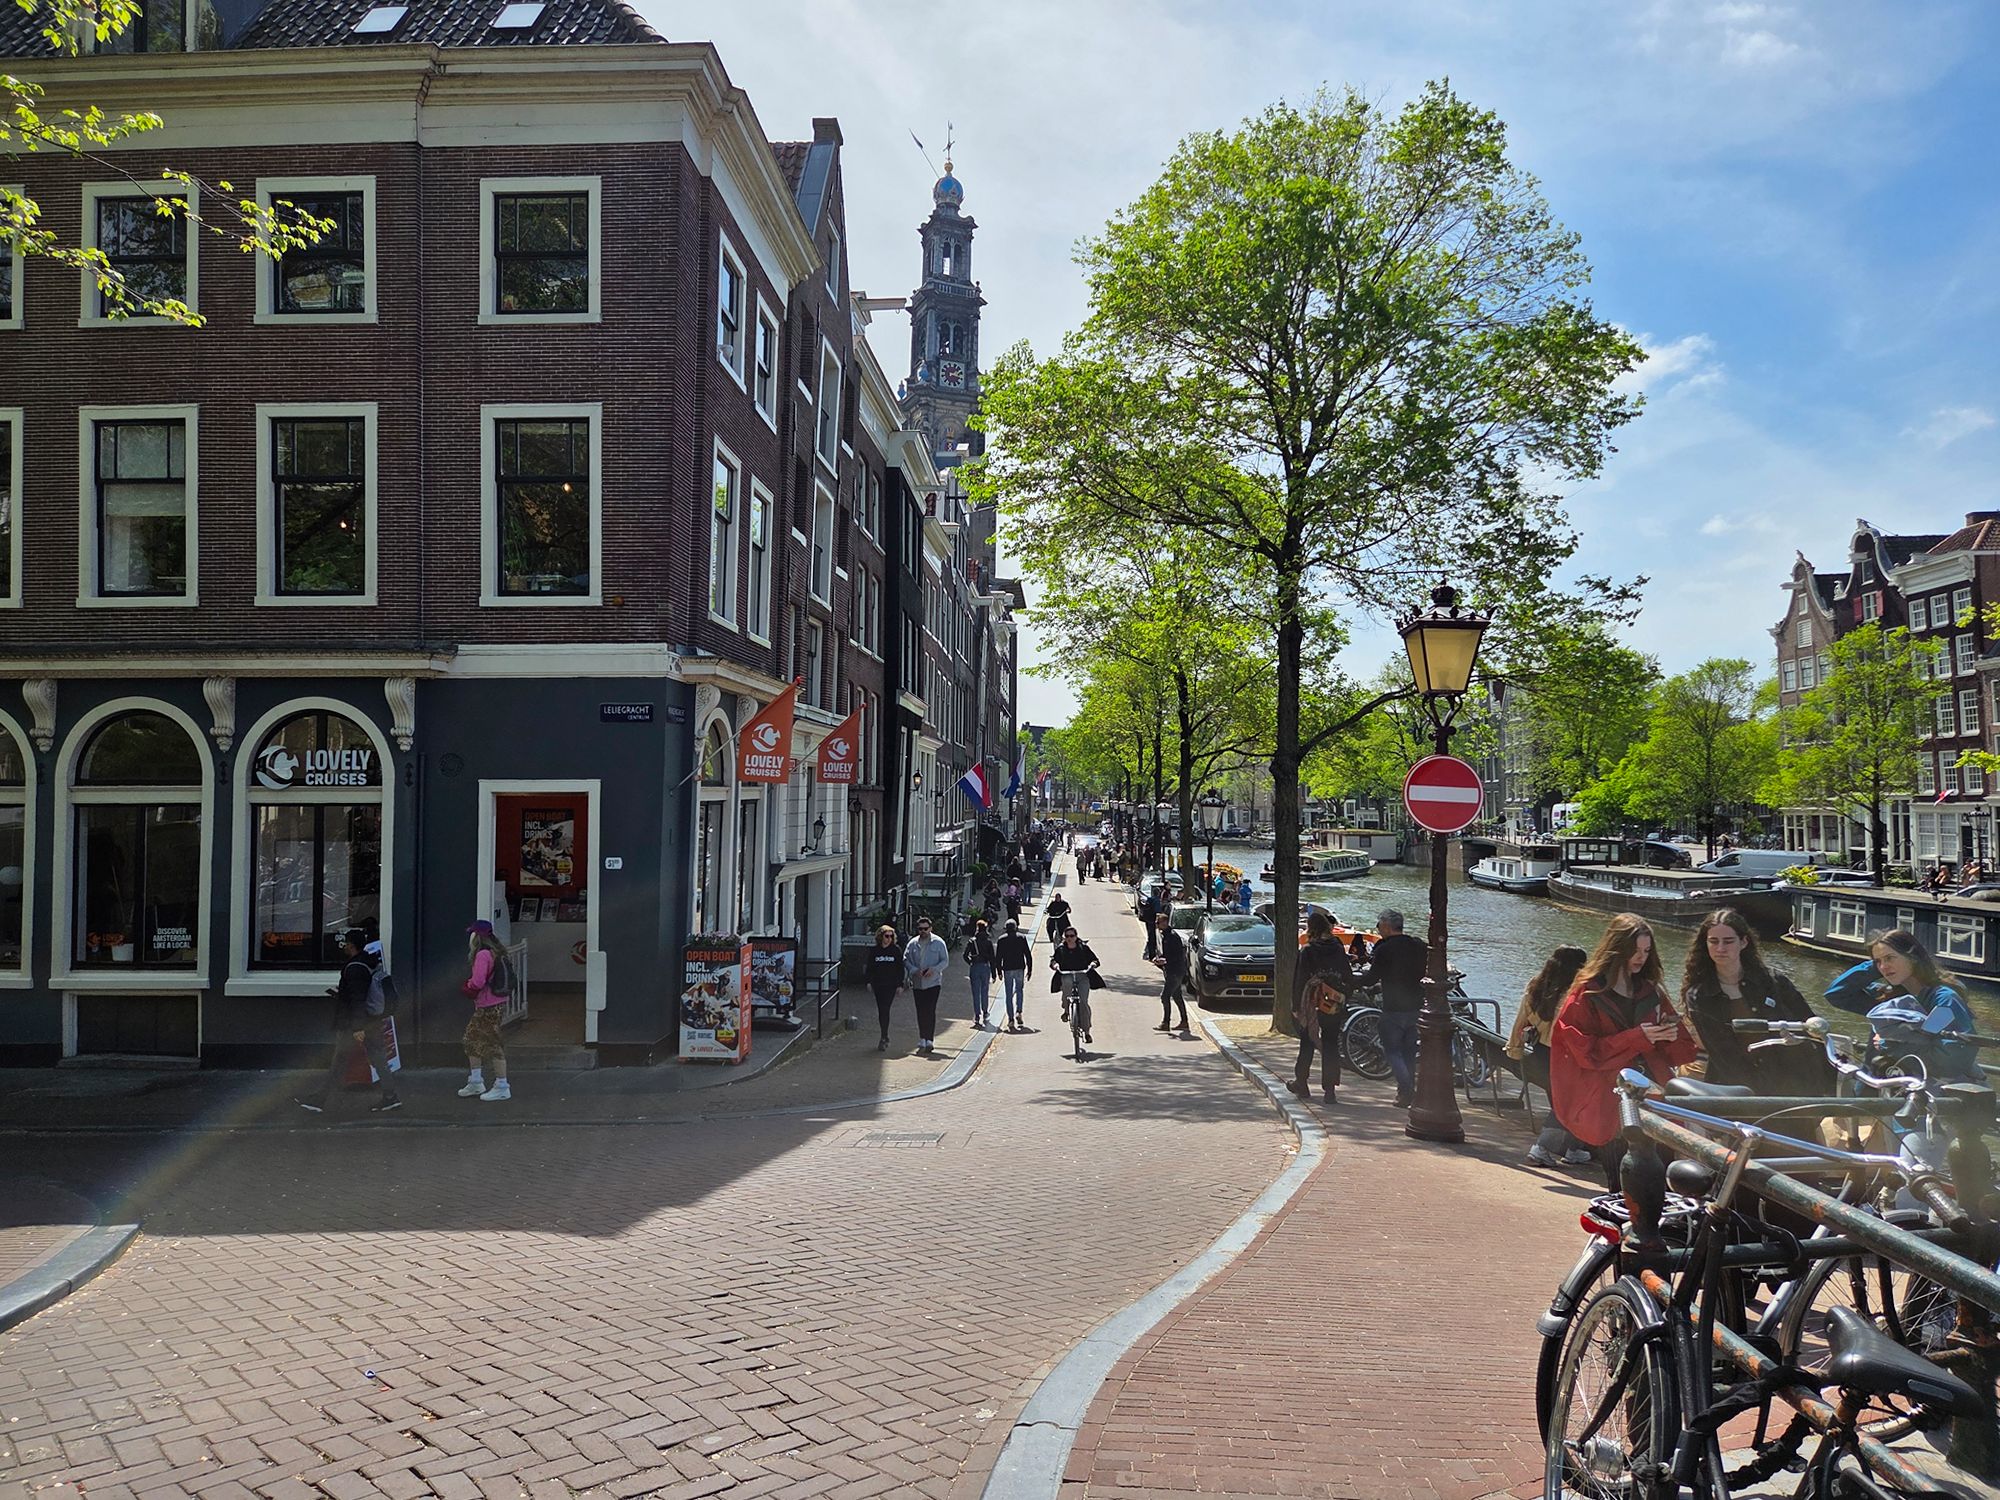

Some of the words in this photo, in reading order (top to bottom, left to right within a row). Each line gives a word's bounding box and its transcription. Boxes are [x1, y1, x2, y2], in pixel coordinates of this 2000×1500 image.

[603, 705, 650, 714] LELIEGRACHT
[305, 749, 372, 772] LOVELY
[745, 754, 785, 769] LOVELY
[823, 761, 853, 773] LOVELY
[744, 768, 781, 777] CRUISES
[822, 772, 851, 780] CRUISES
[305, 772, 367, 786] CRUISES
[152, 934, 192, 942] AMSTERDAM
[153, 941, 166, 949] LIKE
[172, 941, 191, 949] LOCAL
[686, 951, 711, 961] OPEN
[712, 951, 736, 961] BOAT
[752, 958, 776, 966] DRINKS
[685, 962, 709, 973] INCL.
[685, 973, 720, 984] DRINKS
